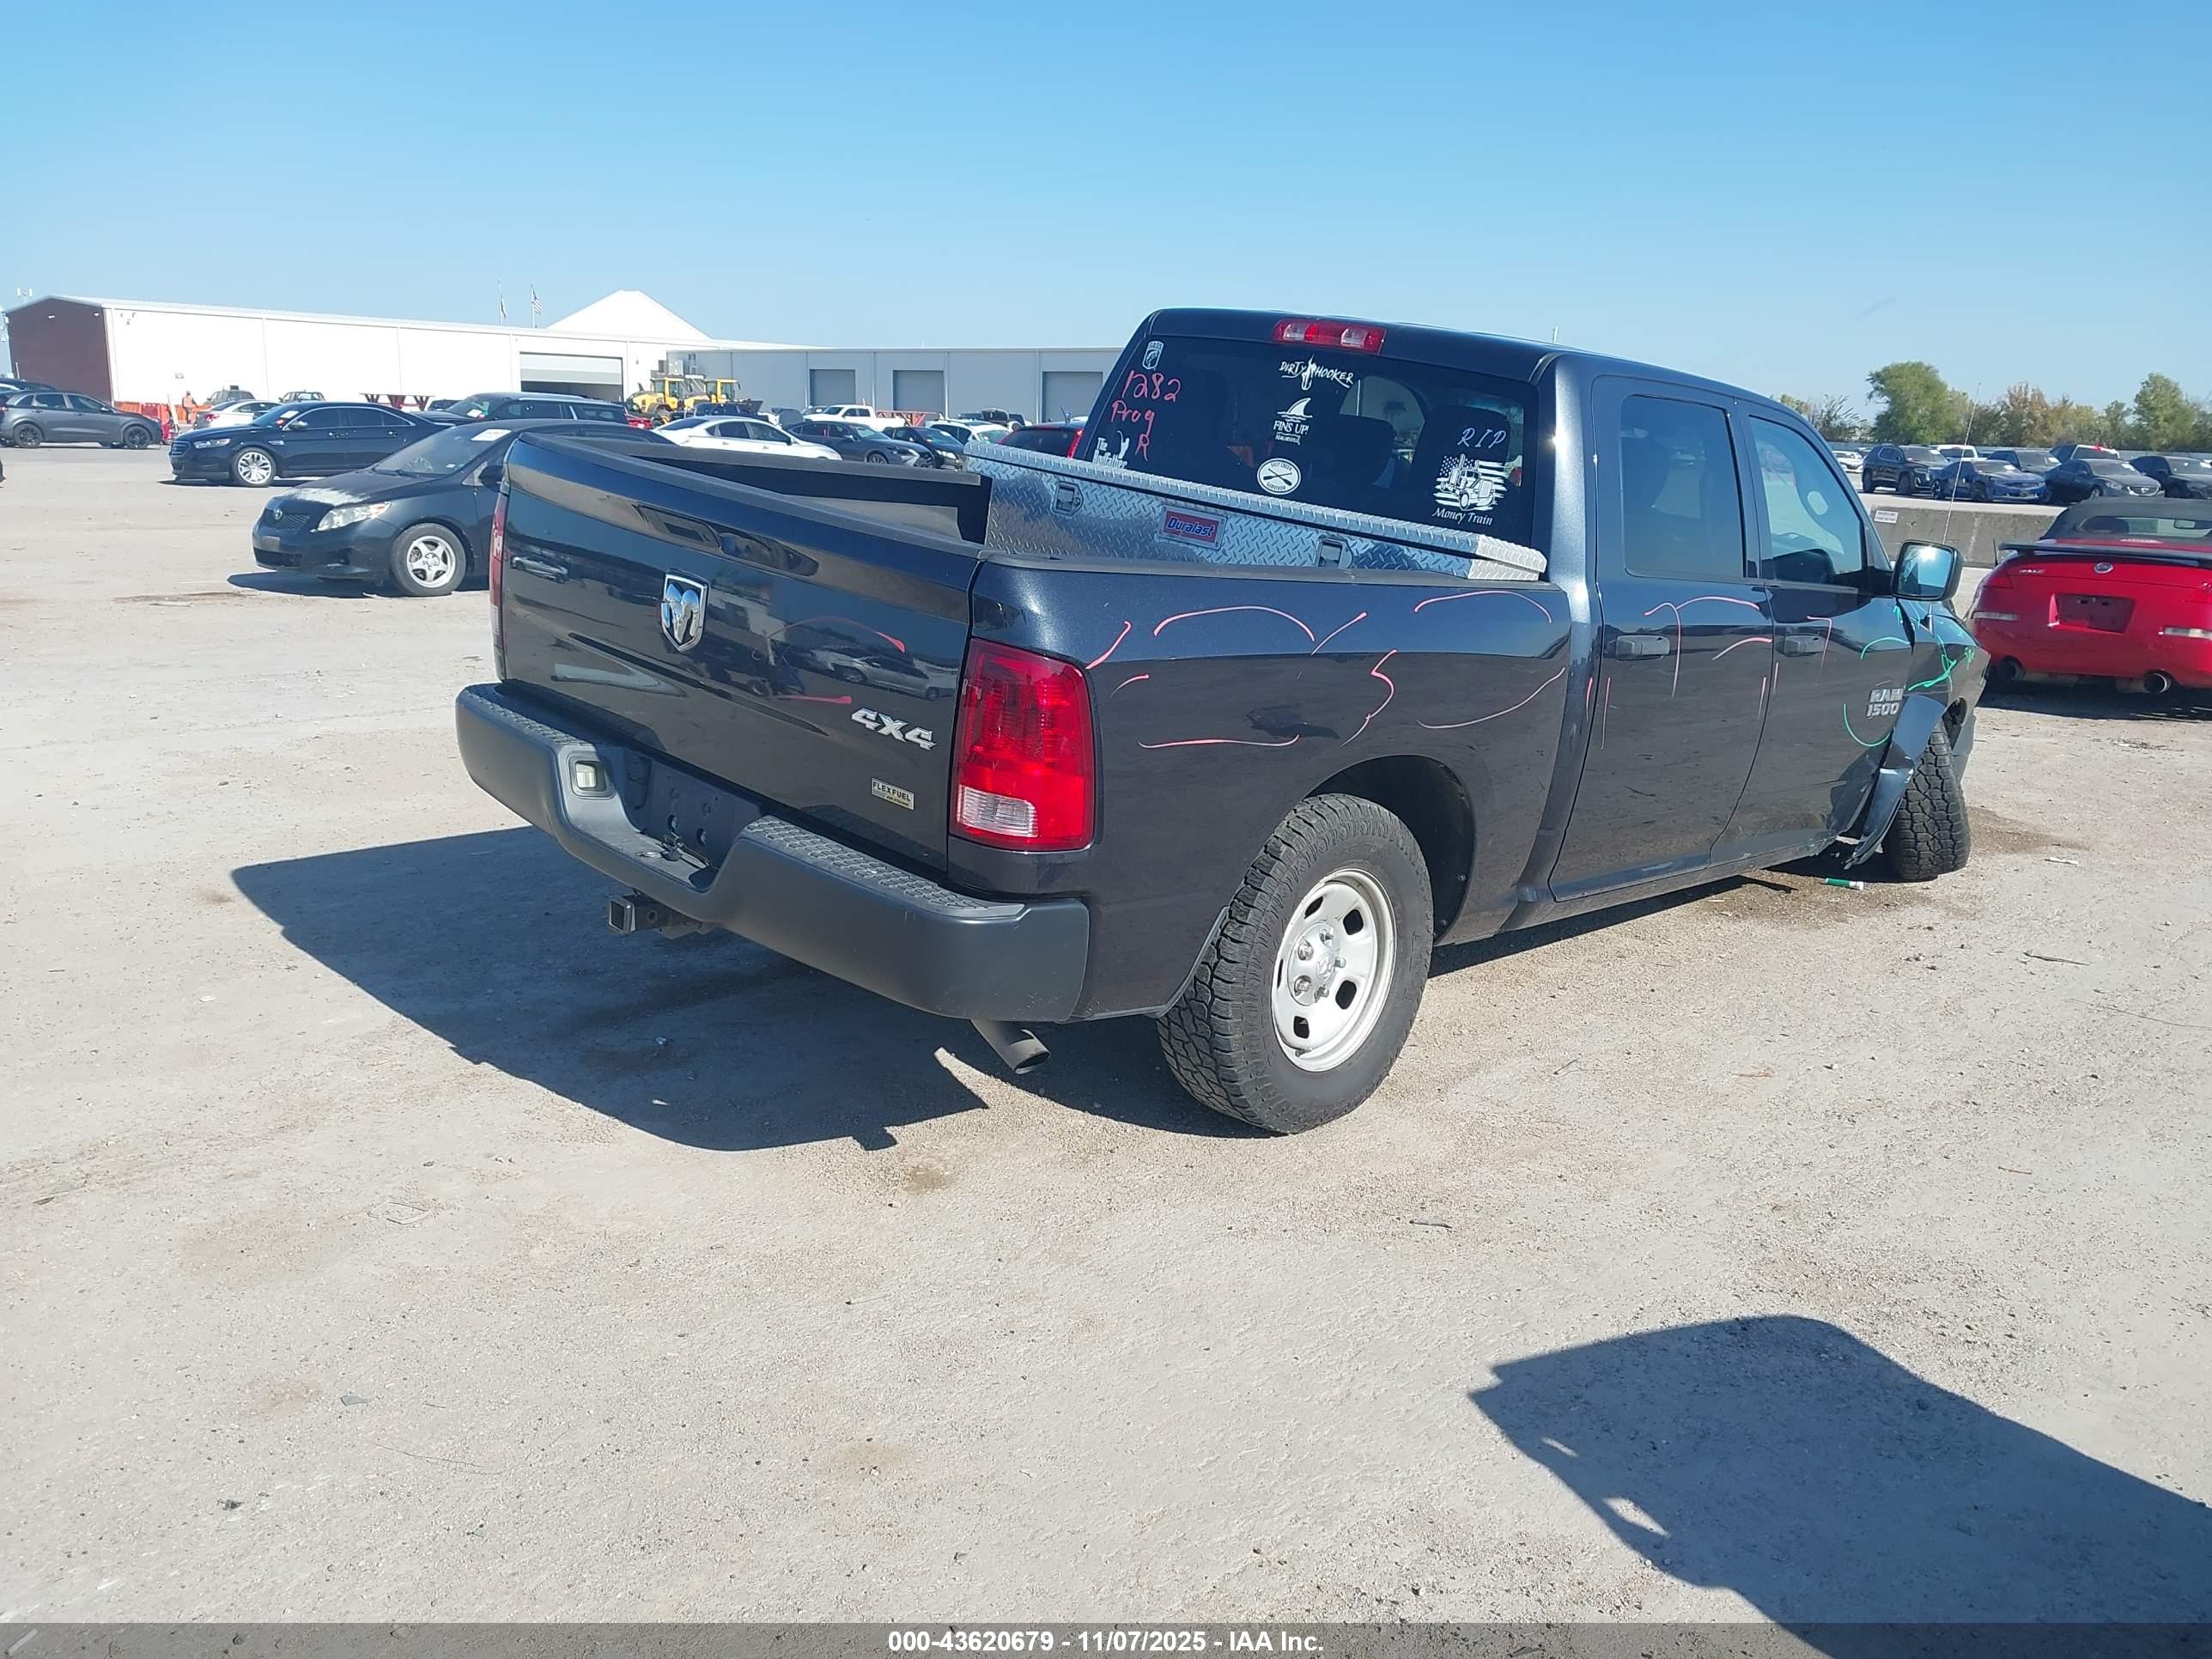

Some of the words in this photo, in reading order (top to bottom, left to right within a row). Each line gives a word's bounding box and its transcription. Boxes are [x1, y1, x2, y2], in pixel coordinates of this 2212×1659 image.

[1279, 361, 1307, 379] DIRTY
[1314, 366, 1354, 388] HOOKER
[1121, 369, 1182, 403] 1282
[1111, 399, 1155, 436] Prog
[1273, 420, 1293, 433] FINS
[1295, 423, 1310, 434] UP!
[1097, 436, 1109, 452] The
[1134, 433, 1150, 461] R
[1431, 507, 1466, 525] Money
[1467, 512, 1493, 526] Train
[1167, 516, 1216, 538] Duralast
[1869, 688, 1904, 702] RAM
[1866, 702, 1899, 718] 1500
